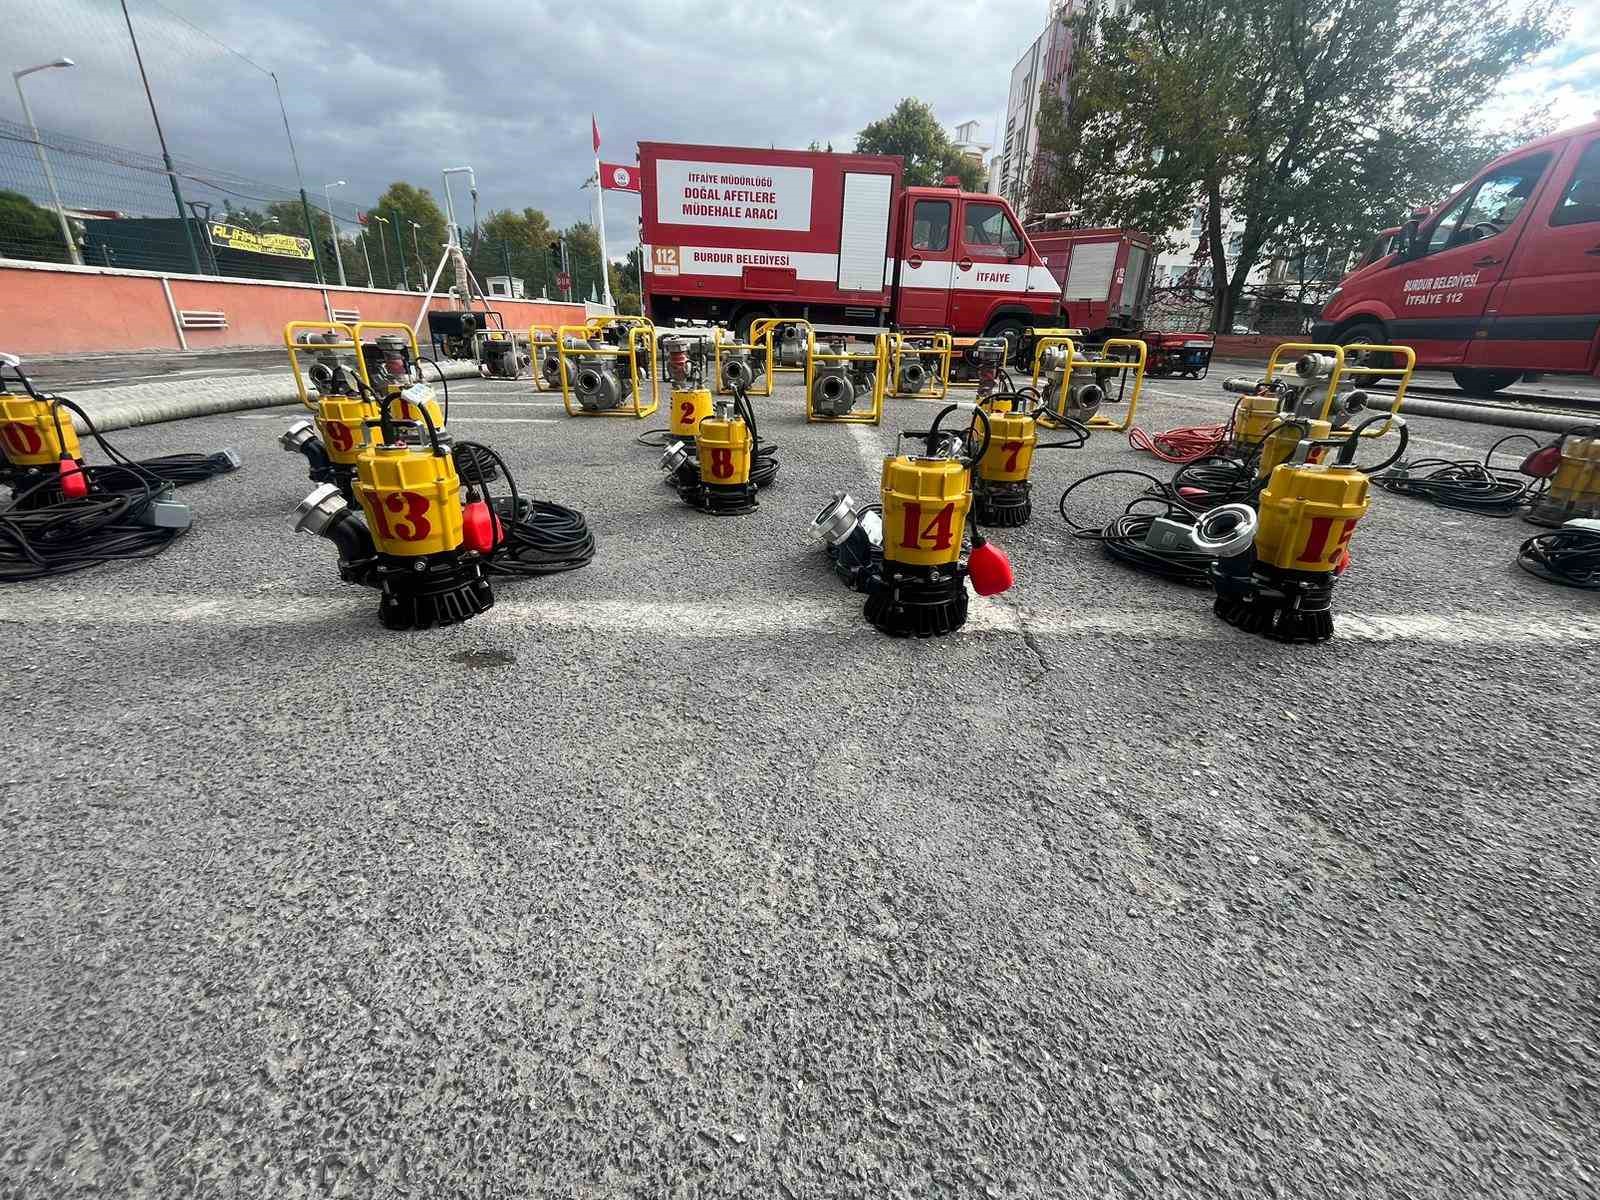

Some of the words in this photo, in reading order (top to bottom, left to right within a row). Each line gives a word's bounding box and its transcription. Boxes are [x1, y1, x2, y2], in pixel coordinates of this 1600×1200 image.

[688, 171, 718, 184] İTFAİYE
[720, 174, 772, 188] MÜDÜRLÜĞÜ
[684, 186, 720, 201] DOĞAL
[723, 189, 776, 204] AFETLERE
[682, 202, 741, 218] MÜDEHALE
[744, 207, 778, 220] ARACI
[656, 248, 676, 263] 112
[693, 251, 733, 264] BURDUR
[736, 253, 790, 266] BELEDİYESİ
[1404, 278, 1434, 291] BURDUR
[1405, 293, 1443, 306] İTFAİYE
[1446, 292, 1464, 304] 112
[680, 402, 696, 425] 2
[327, 420, 353, 452] 9
[711, 447, 735, 479] 8
[1001, 441, 1025, 473] 7
[362, 491, 432, 542] 13
[899, 502, 956, 551] 14
